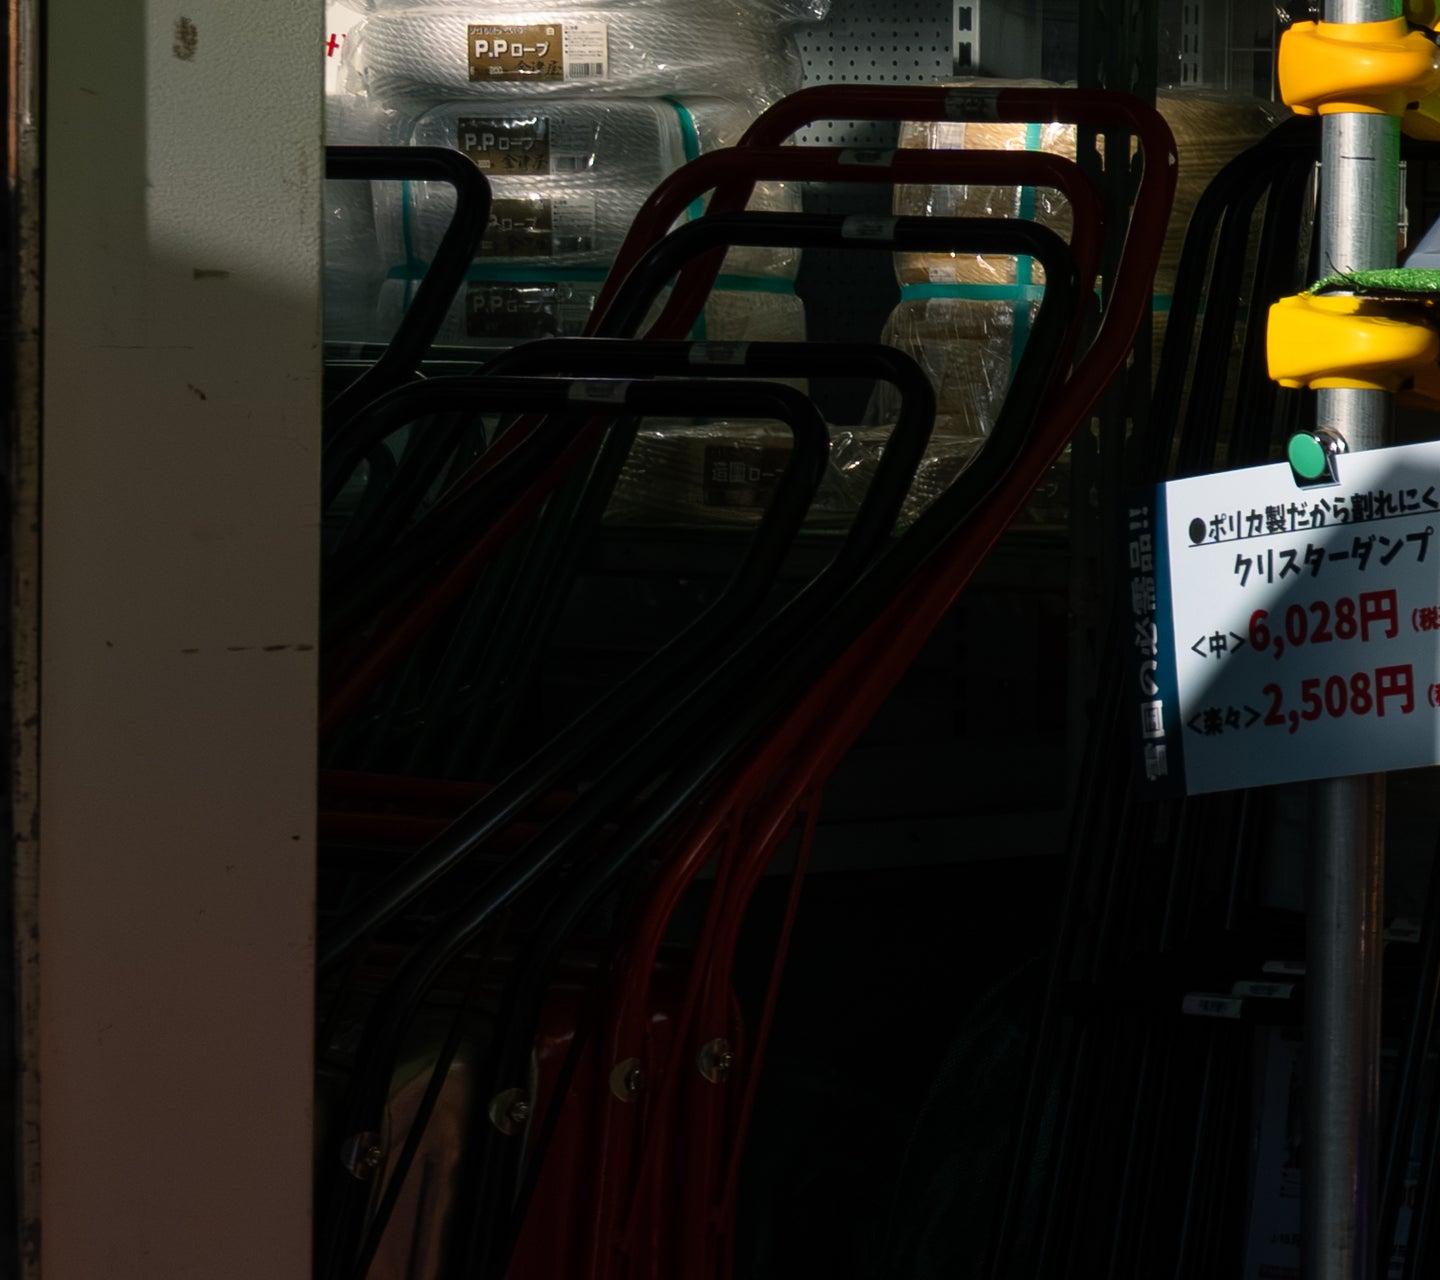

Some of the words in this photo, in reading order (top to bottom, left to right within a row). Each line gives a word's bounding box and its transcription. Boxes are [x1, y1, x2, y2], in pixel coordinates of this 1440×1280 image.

[1235, 527, 1434, 587] クリスターダンプ
[1248, 589, 1399, 659] 6,028円
[1262, 664, 1414, 735] 2,508円
